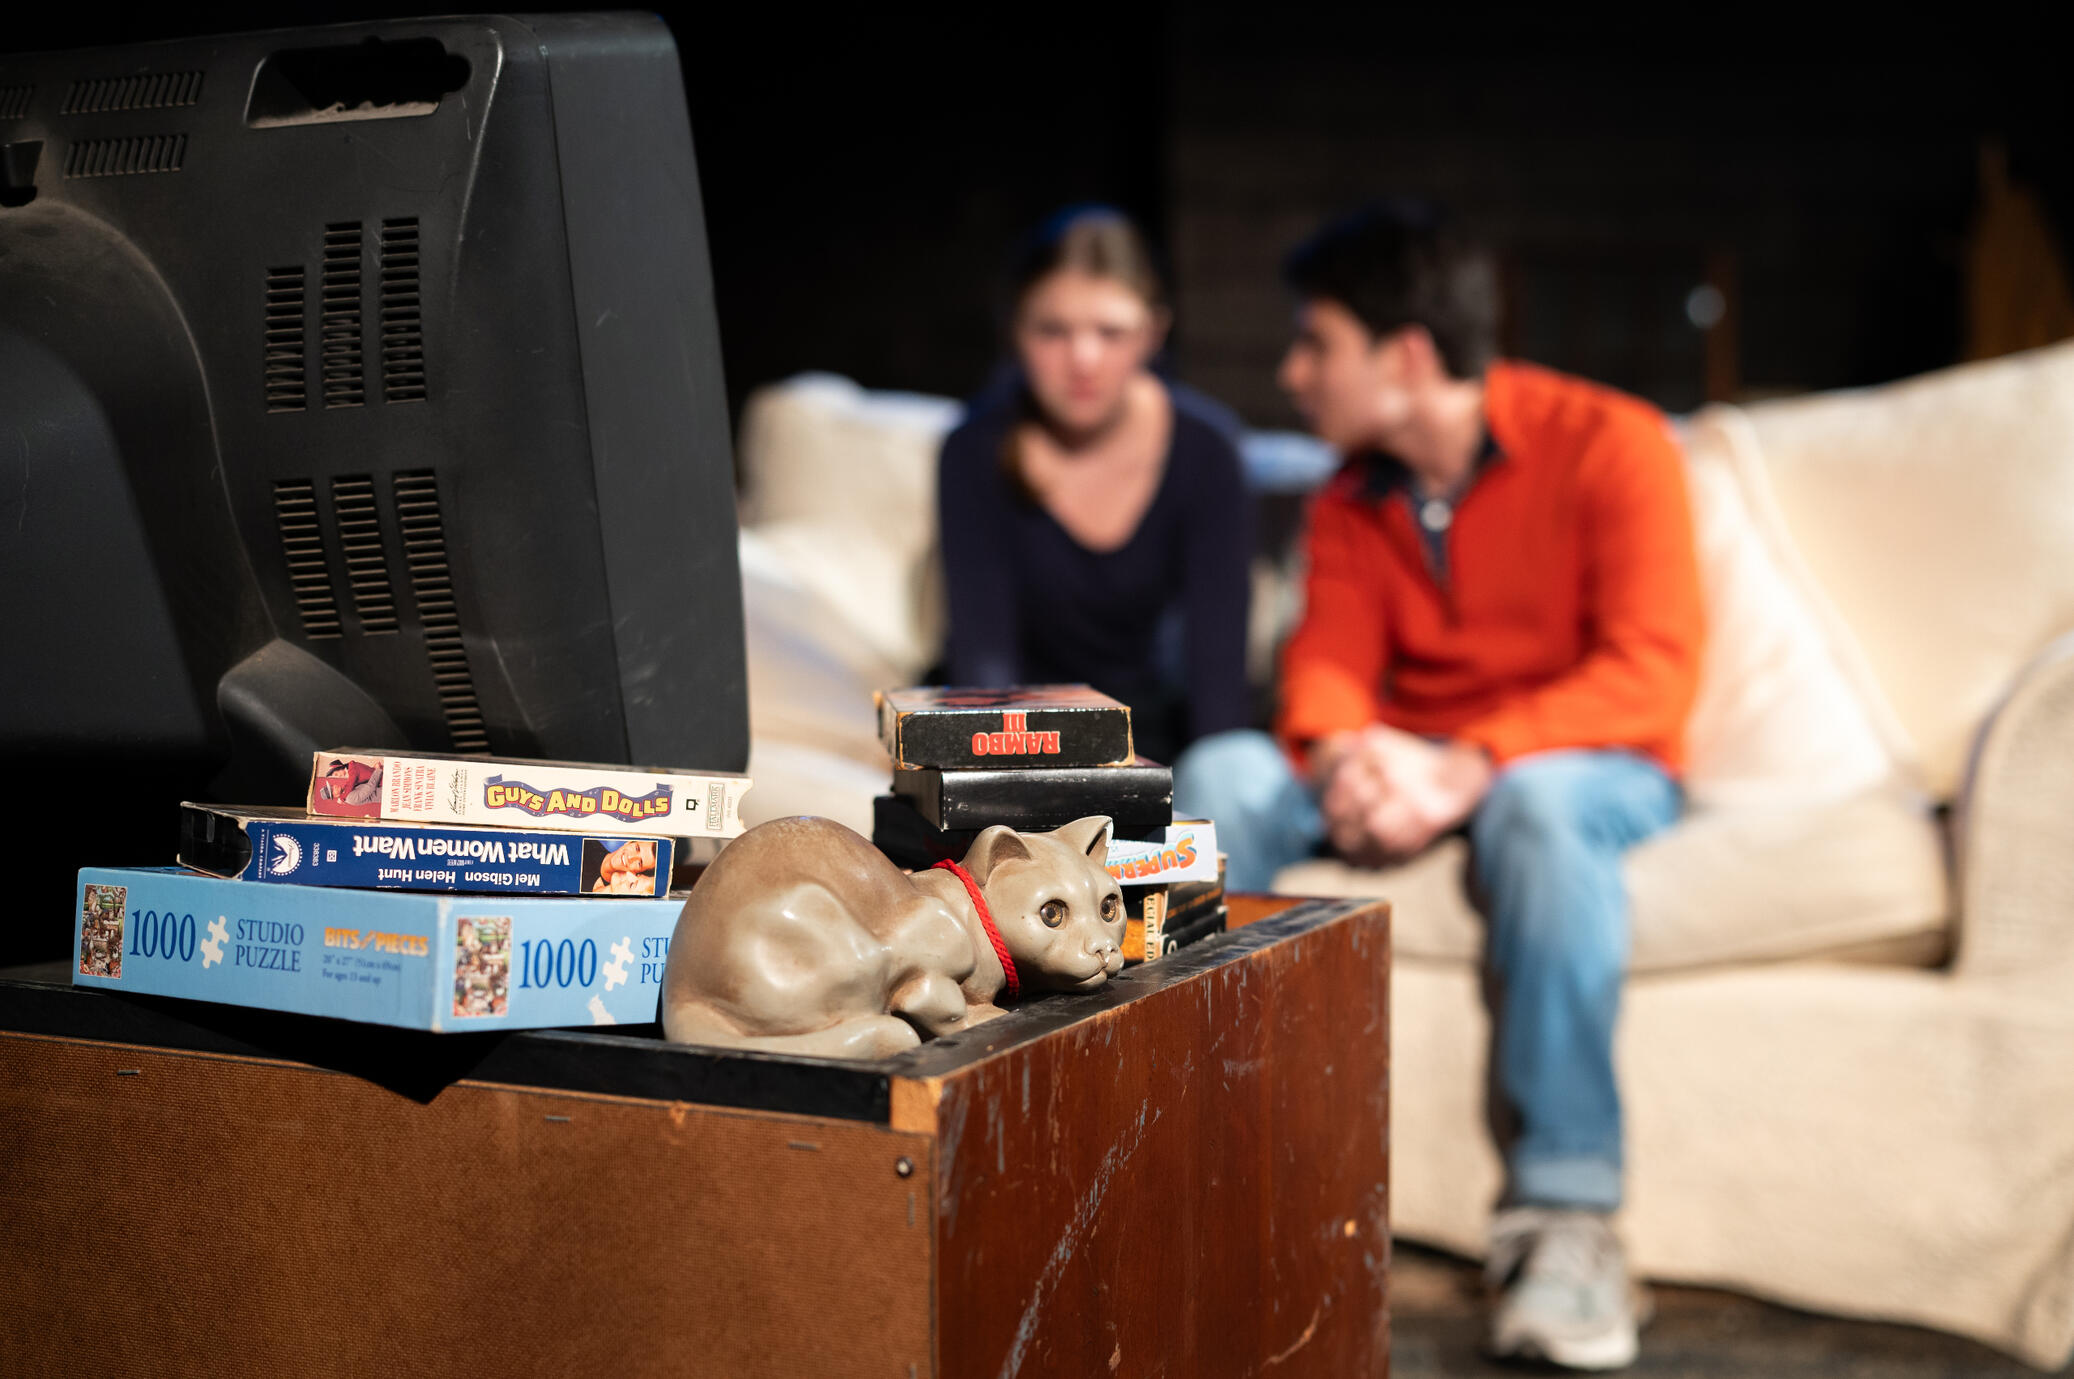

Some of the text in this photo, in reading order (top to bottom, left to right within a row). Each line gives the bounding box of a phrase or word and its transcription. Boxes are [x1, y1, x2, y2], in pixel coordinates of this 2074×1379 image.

[1002, 712, 1028, 732] III
[972, 731, 1060, 756] RAMBO
[390, 761, 401, 813] MARLON BRANDO
[401, 767, 412, 810] JEAN SIMMONS
[413, 766, 424, 812] FRANK SINATRA
[425, 768, 436, 810] VIVIAN BLAINE
[486, 784, 670, 819] GUYS AND DOLLS
[353, 835, 570, 866] What Women Want
[377, 868, 541, 886] Mel Gibson Helen Hunt
[129, 909, 196, 962] 1000
[236, 918, 304, 946] STUDIO
[235, 944, 302, 973] PUZZLE
[518, 938, 598, 989] 1000
